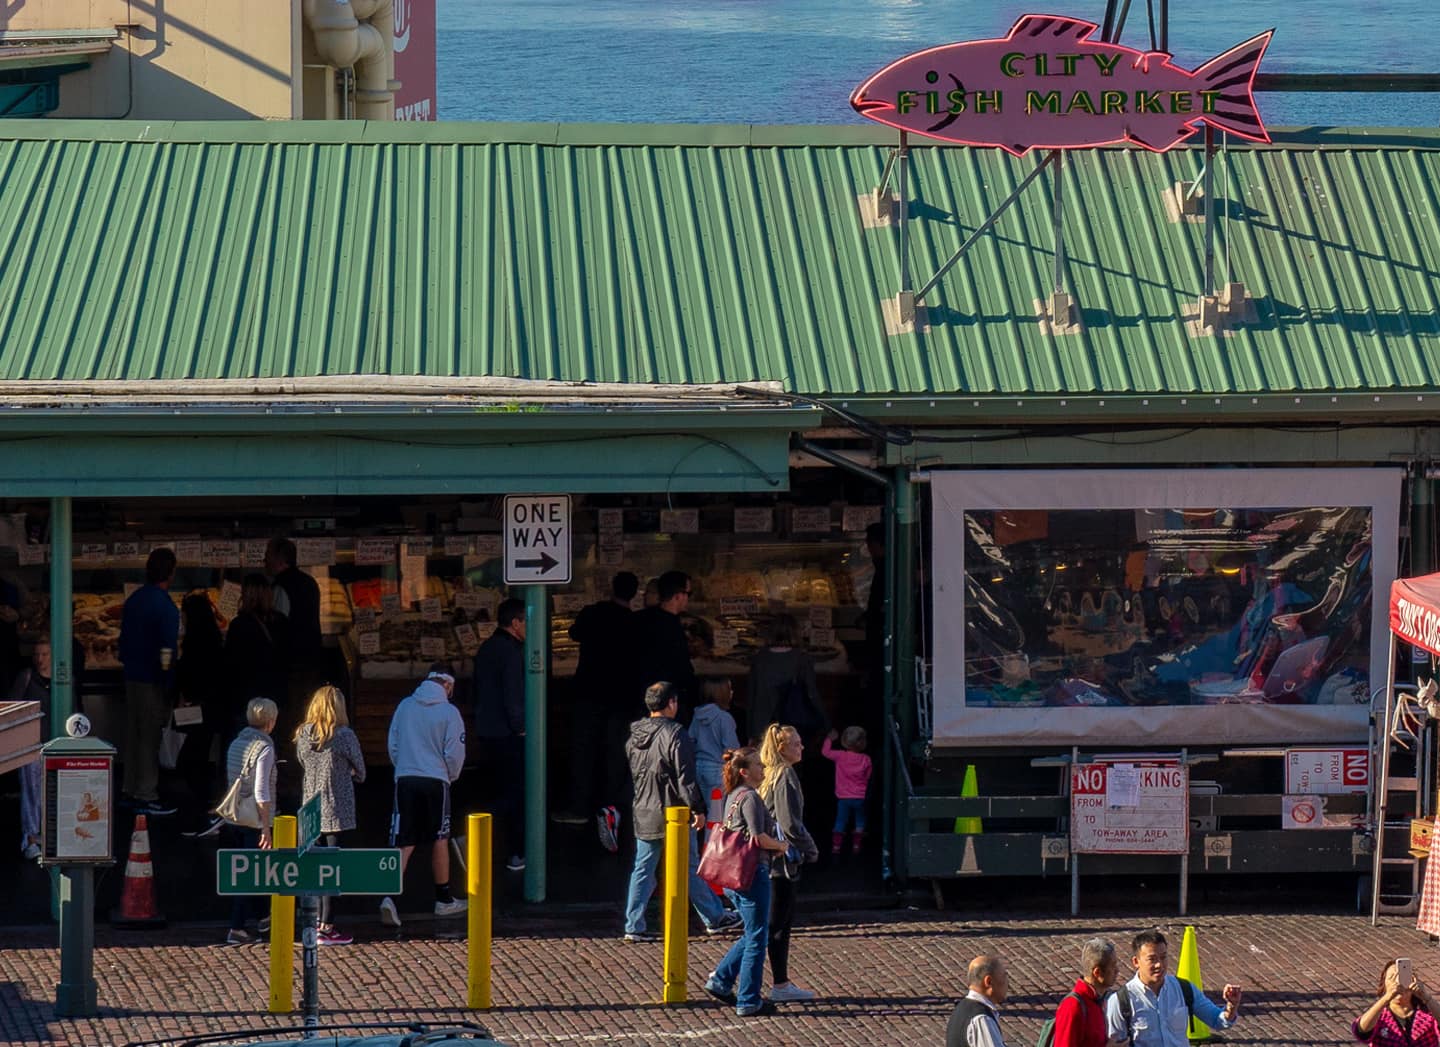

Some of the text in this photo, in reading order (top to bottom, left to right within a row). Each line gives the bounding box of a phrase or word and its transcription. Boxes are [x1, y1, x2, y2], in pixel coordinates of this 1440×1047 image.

[1000, 51, 1123, 78] CITY
[897, 89, 1222, 115] FISH MARKET
[513, 503, 562, 523] ONE
[512, 527, 563, 548] WAY
[1314, 762, 1324, 774] TO
[1330, 754, 1340, 781] FROM
[1346, 754, 1368, 781] NO
[1077, 769, 1103, 791] NO
[1140, 771, 1181, 788] KING
[1301, 770, 1310, 793] TOW-
[1077, 798, 1103, 808] FROM
[1085, 815, 1096, 824] TO
[1092, 828, 1169, 839] TOW-AWAY AREA
[231, 854, 397, 887] Pike Pl 60
